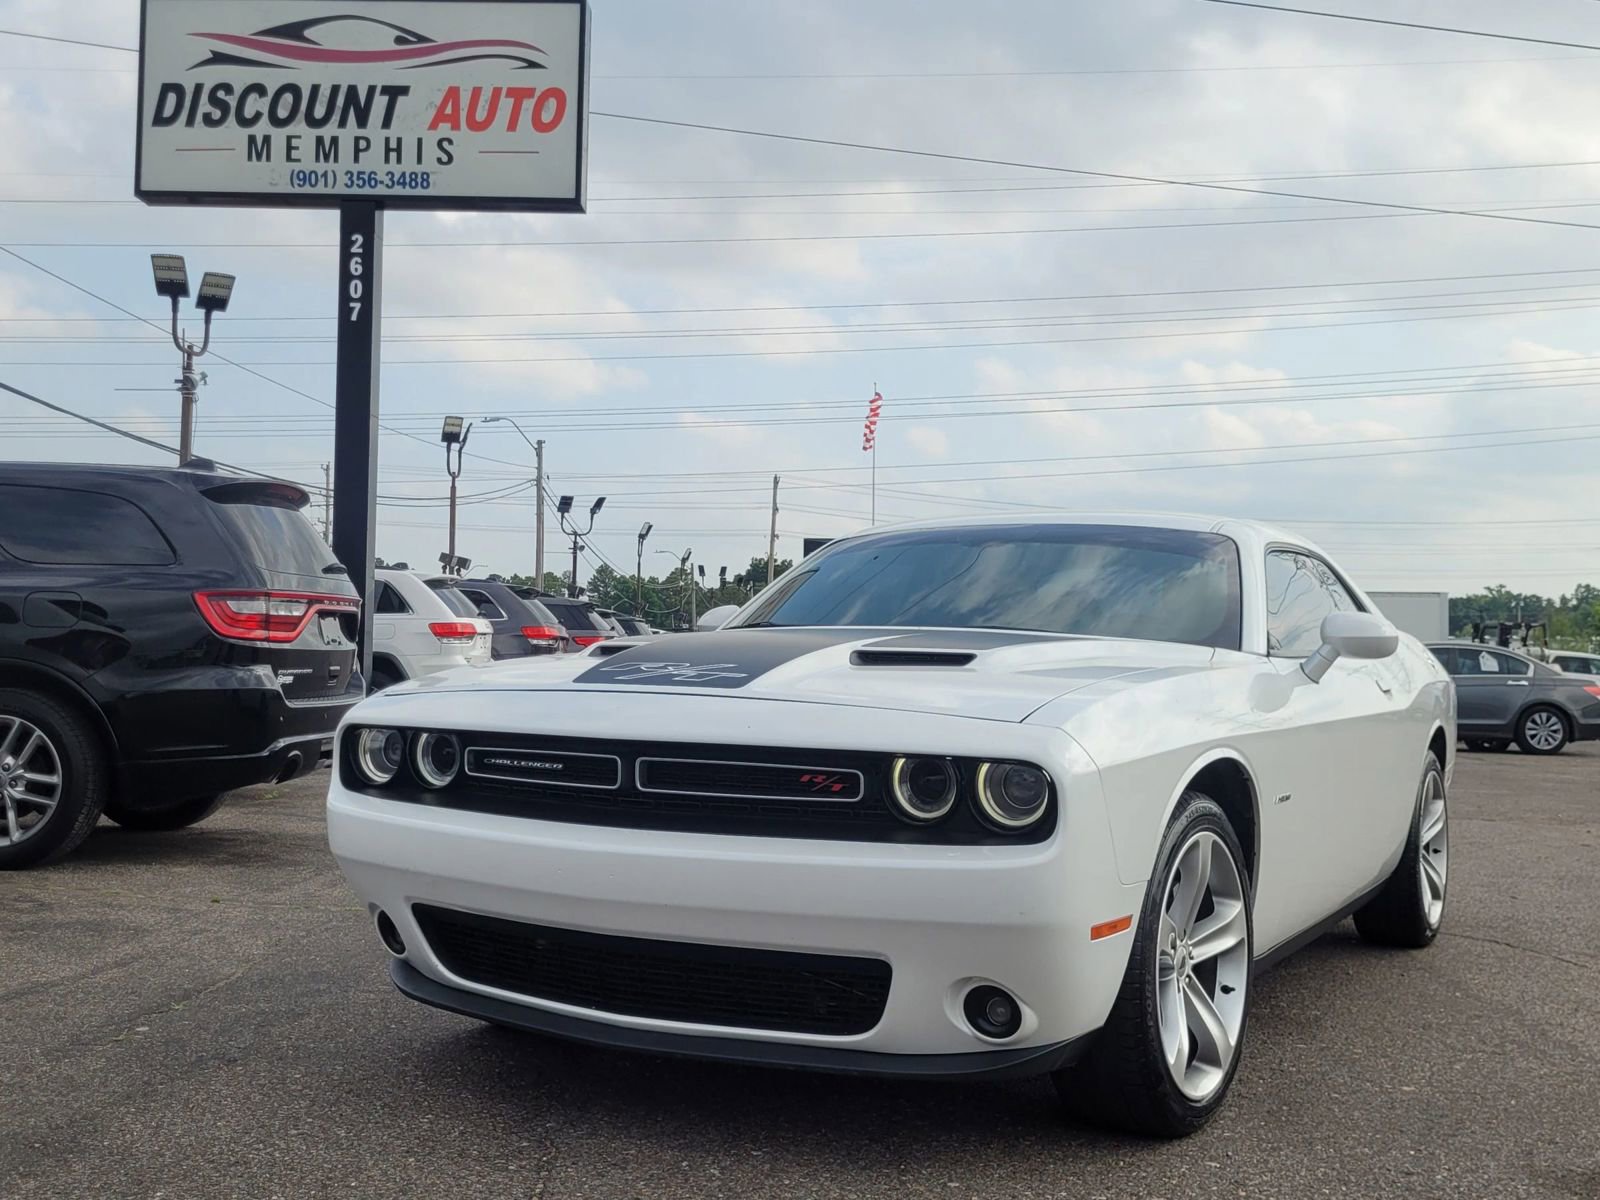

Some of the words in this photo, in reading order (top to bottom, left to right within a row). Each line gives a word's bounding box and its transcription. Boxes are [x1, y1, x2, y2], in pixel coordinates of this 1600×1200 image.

[151, 82, 411, 130] DISCOUNT
[427, 86, 567, 133] AUTO
[247, 134, 454, 166] MEMPHIS
[289, 170, 337, 190] (901)
[344, 171, 431, 190] 356-3488
[349, 234, 364, 321] 2607
[600, 662, 748, 682] R/T
[484, 758, 563, 769] CHALLENGER
[800, 773, 850, 791] R/T
